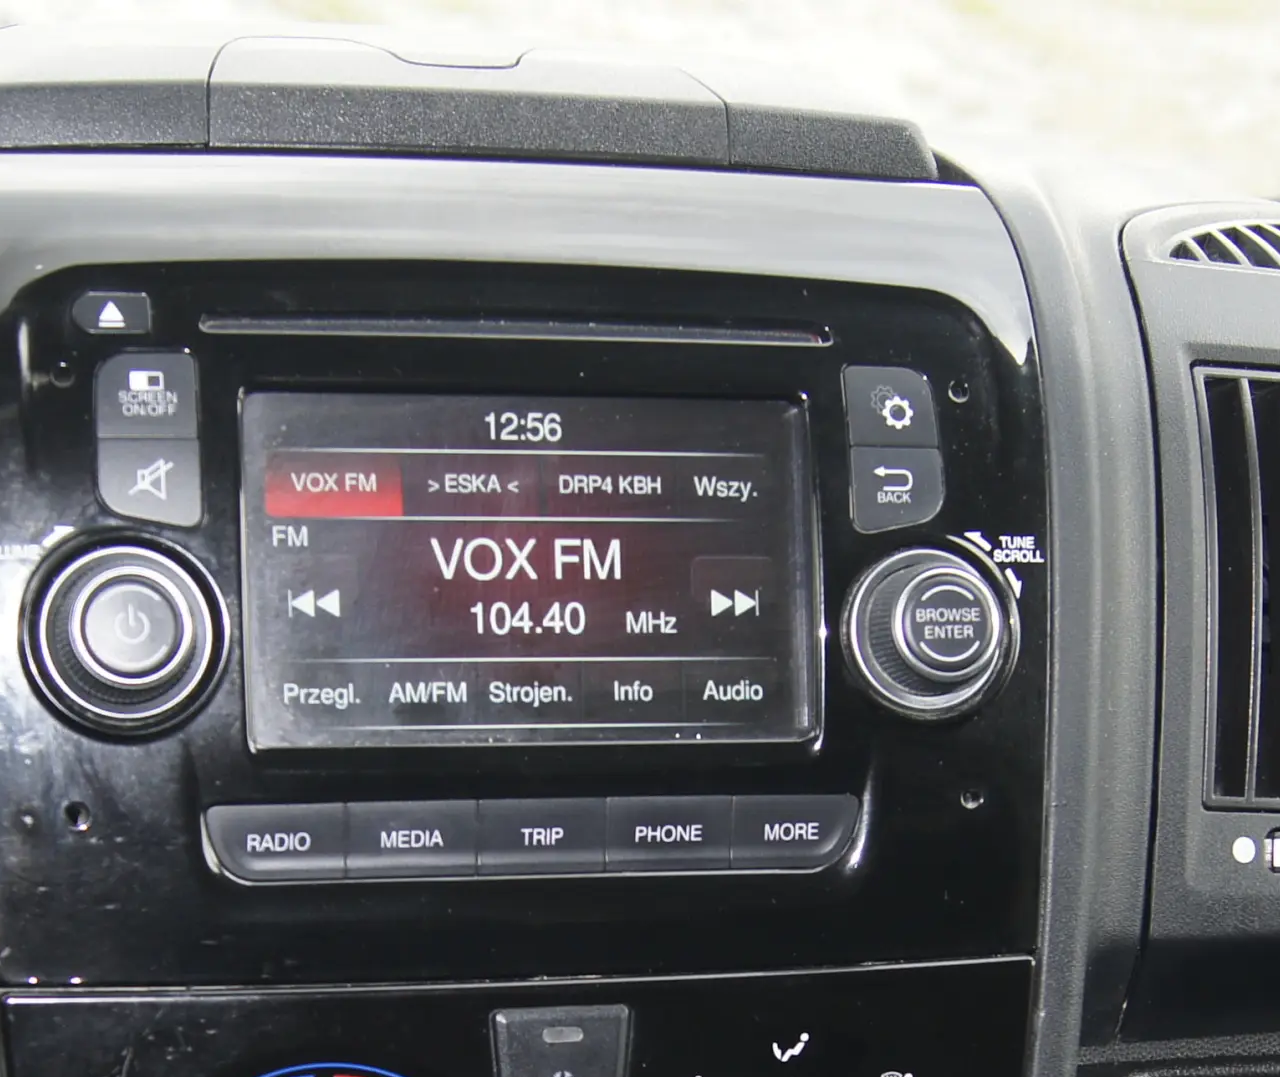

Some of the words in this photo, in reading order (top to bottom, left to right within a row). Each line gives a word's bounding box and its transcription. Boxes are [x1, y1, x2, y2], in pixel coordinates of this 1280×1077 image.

[118, 390, 178, 404] SCREEN
[484, 411, 562, 442] 12:56
[291, 472, 338, 492] VOX
[344, 473, 377, 492] FM
[445, 474, 502, 493] ESKA
[558, 475, 613, 494] DRP4
[619, 476, 662, 495] KBH
[693, 476, 758, 502] Wszy.
[877, 491, 912, 504] BACK
[271, 525, 309, 547] FM
[999, 536, 1035, 549] TUNE
[430, 537, 538, 581] VOX
[554, 538, 621, 580] FM
[993, 549, 1045, 563] SCROLL
[470, 601, 586, 635] 104.40
[625, 611, 678, 634] MHz
[915, 607, 981, 623] BROWSE
[924, 625, 974, 640] ENTER
[283, 682, 361, 710] Przegl.
[388, 681, 467, 704] AM/FM
[488, 680, 573, 708] Strojen.
[613, 680, 654, 702] Info
[702, 679, 764, 701] Audio
[380, 829, 444, 849] MEDIA
[521, 827, 564, 846] TRIP
[634, 824, 703, 843] PHONE
[764, 822, 820, 841] MORE
[246, 832, 312, 853] RADIO
